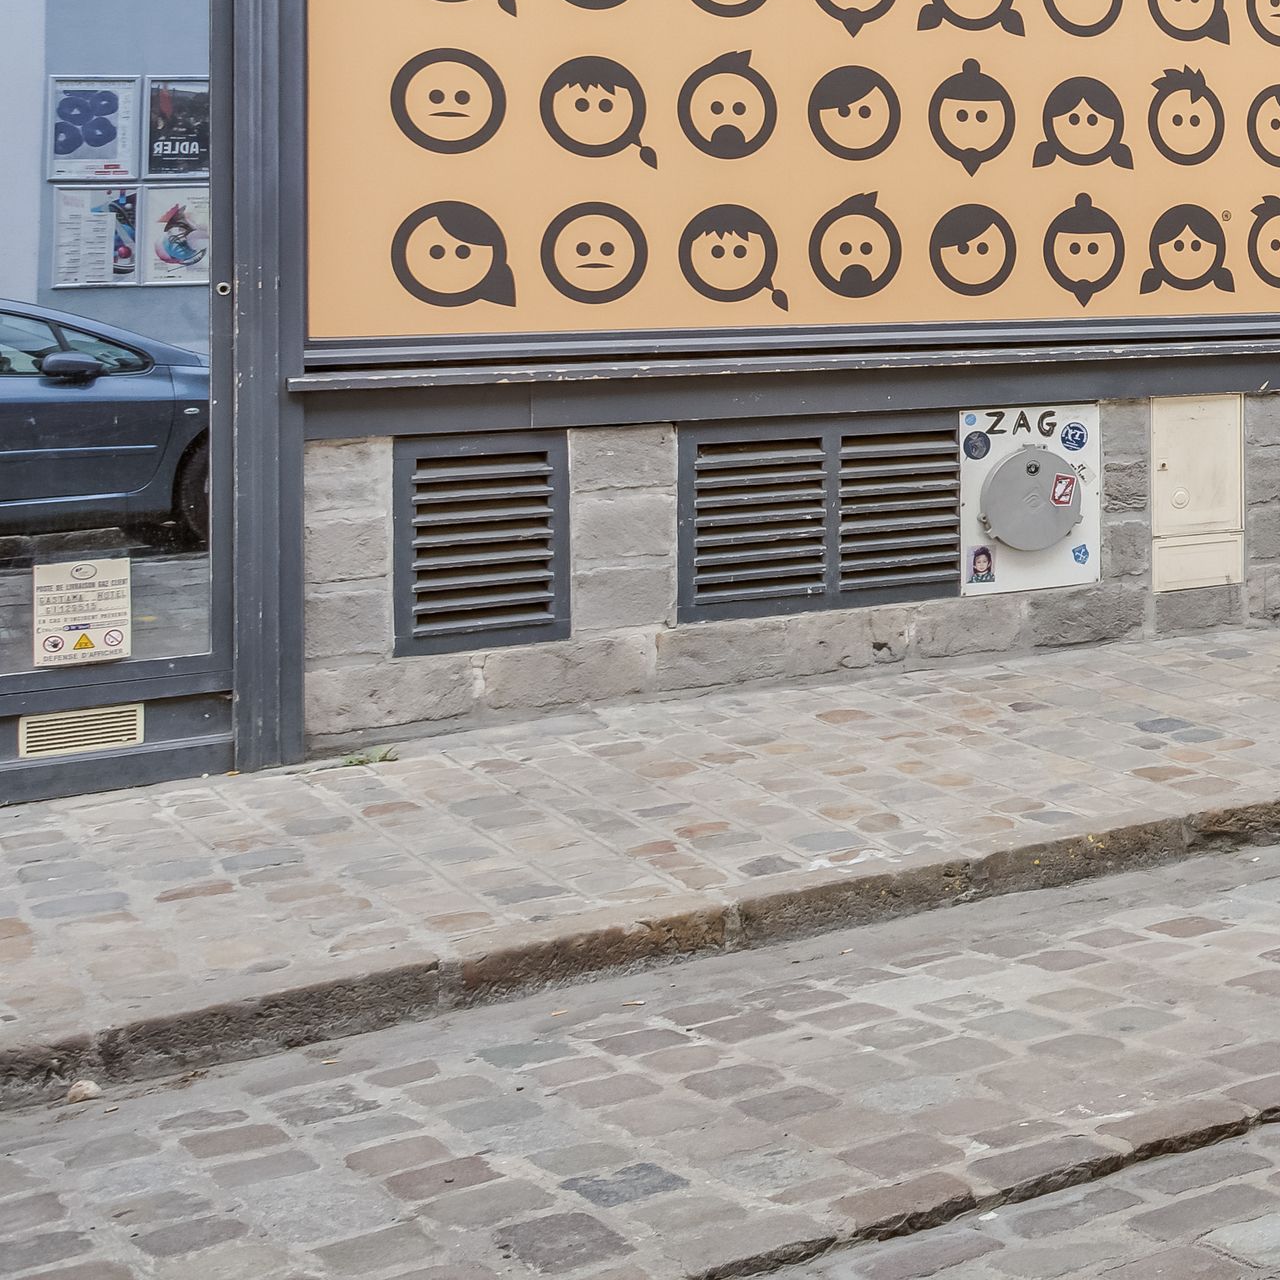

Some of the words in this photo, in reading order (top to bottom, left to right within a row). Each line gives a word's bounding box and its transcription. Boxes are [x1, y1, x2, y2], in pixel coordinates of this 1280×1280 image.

[985, 410, 1058, 437] ZAG
[97, 590, 126, 601] HOTEL
[81, 648, 124, 659] D'AFFICHER
